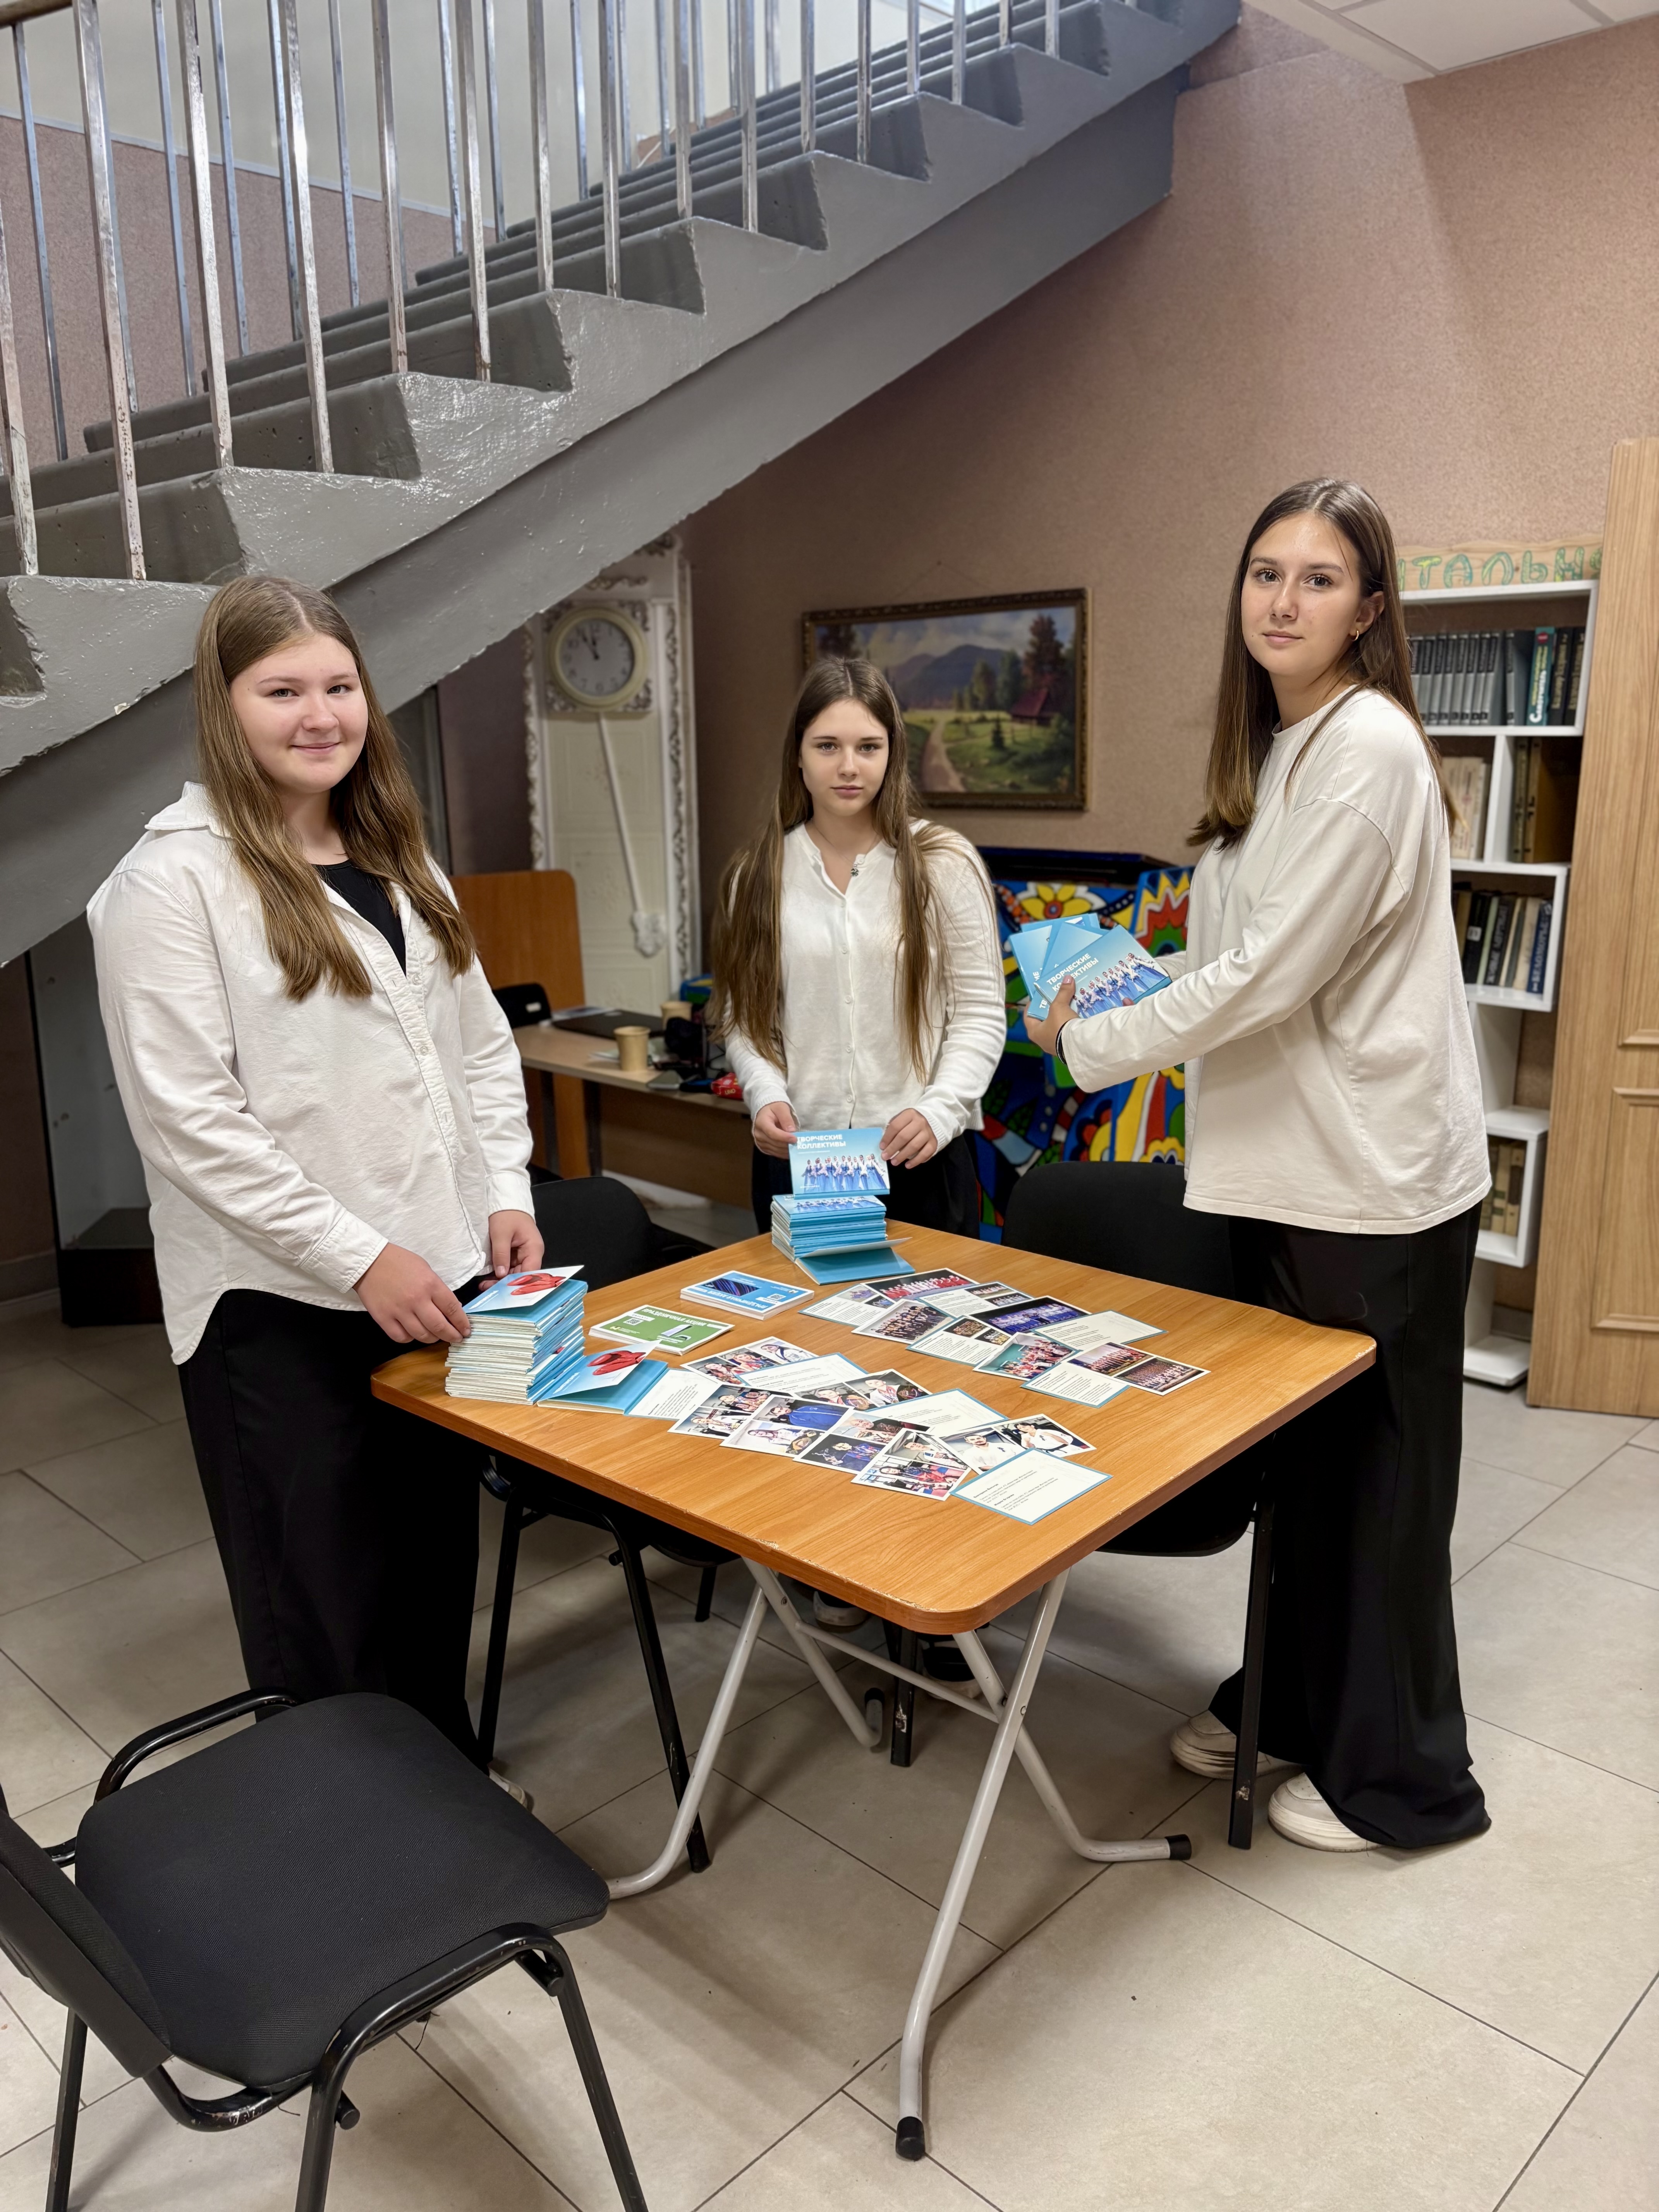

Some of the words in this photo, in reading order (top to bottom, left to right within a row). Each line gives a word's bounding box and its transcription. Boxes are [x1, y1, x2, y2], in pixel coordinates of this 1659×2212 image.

[1046, 953, 1091, 985] ТВОРЧЕСКИЕ
[1052, 958, 1099, 992] КОЕКТИВЫ
[797, 1134, 843, 1142] ТВОРЧЕСКИЕ
[797, 1141, 846, 1149] КОЛЛЕКТИВЫ
[641, 1308, 687, 1322] ПРАЗДНИЧНАЯ
